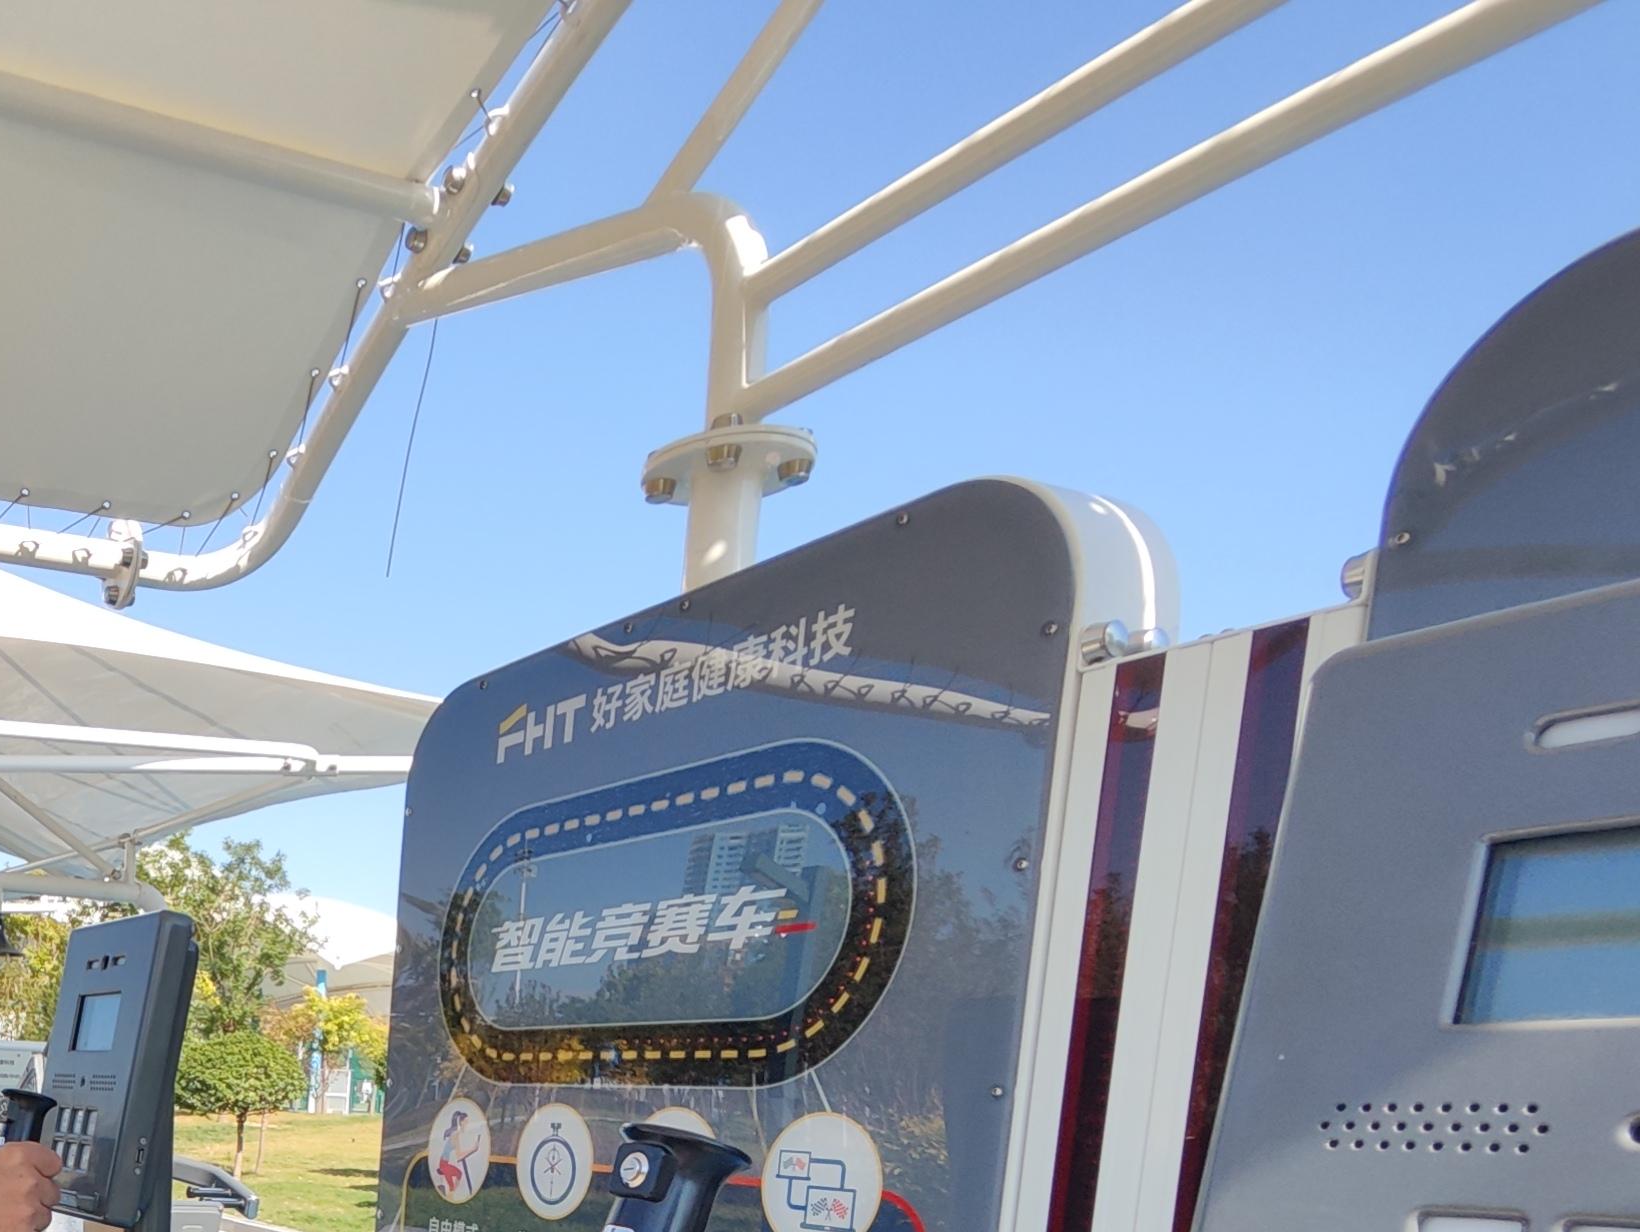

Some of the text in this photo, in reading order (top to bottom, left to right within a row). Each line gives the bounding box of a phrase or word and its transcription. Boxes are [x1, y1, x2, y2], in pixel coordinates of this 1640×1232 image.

[496, 603, 856, 765] FHT 好家庭健康科技
[490, 885, 788, 973] 智能竞赛车
